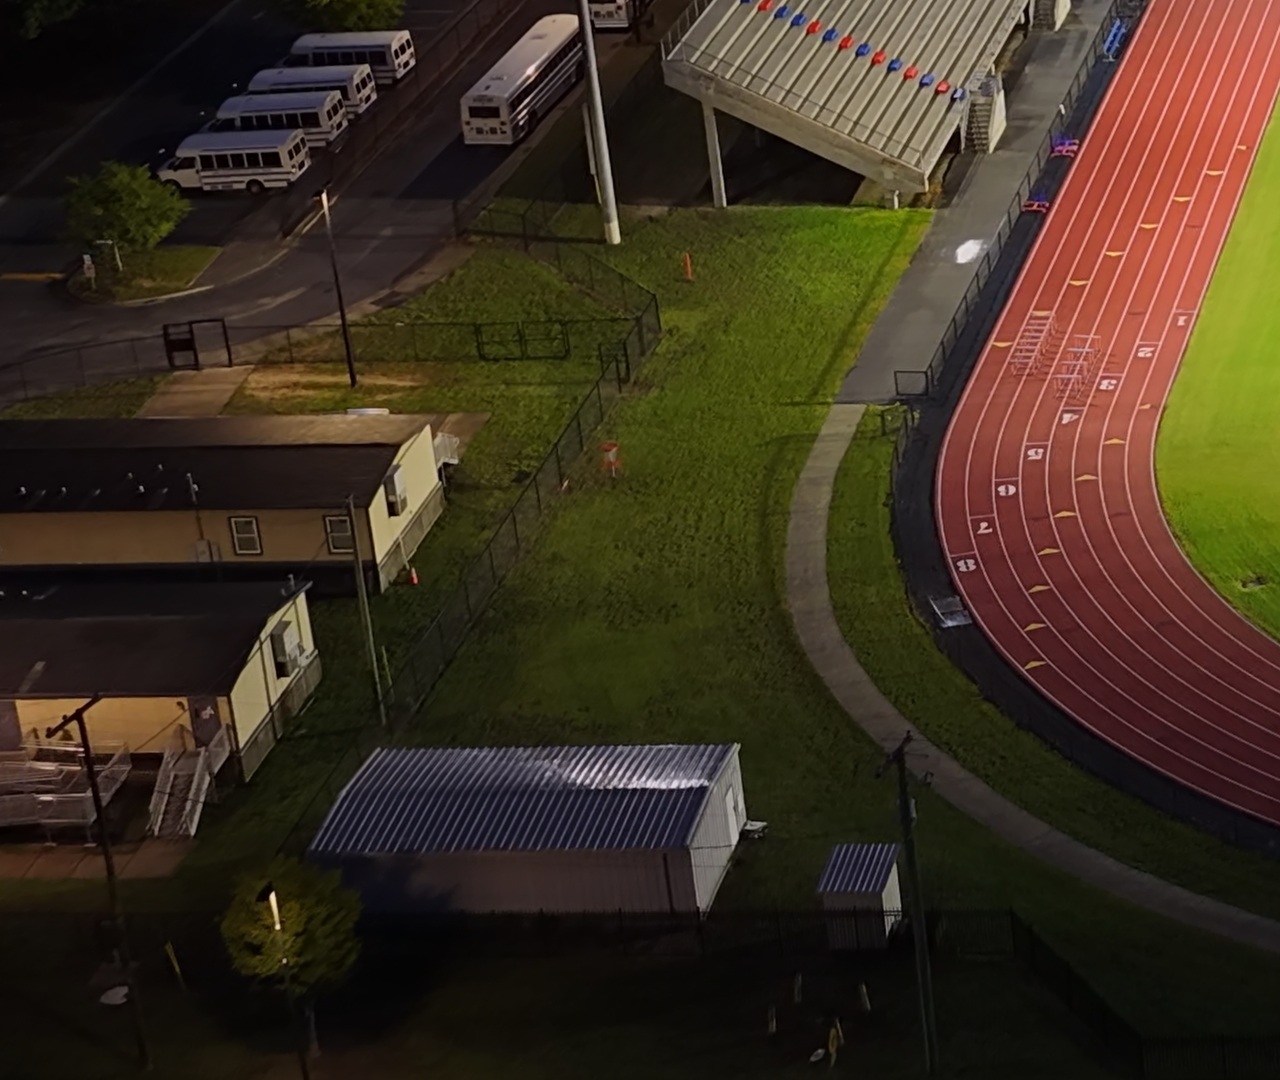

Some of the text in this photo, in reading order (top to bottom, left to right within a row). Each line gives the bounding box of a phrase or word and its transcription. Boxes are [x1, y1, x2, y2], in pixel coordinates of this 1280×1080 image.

[1177, 316, 1188, 326] 1
[1027, 448, 1044, 460] 5
[977, 522, 993, 534] 7
[956, 559, 976, 572] 8
